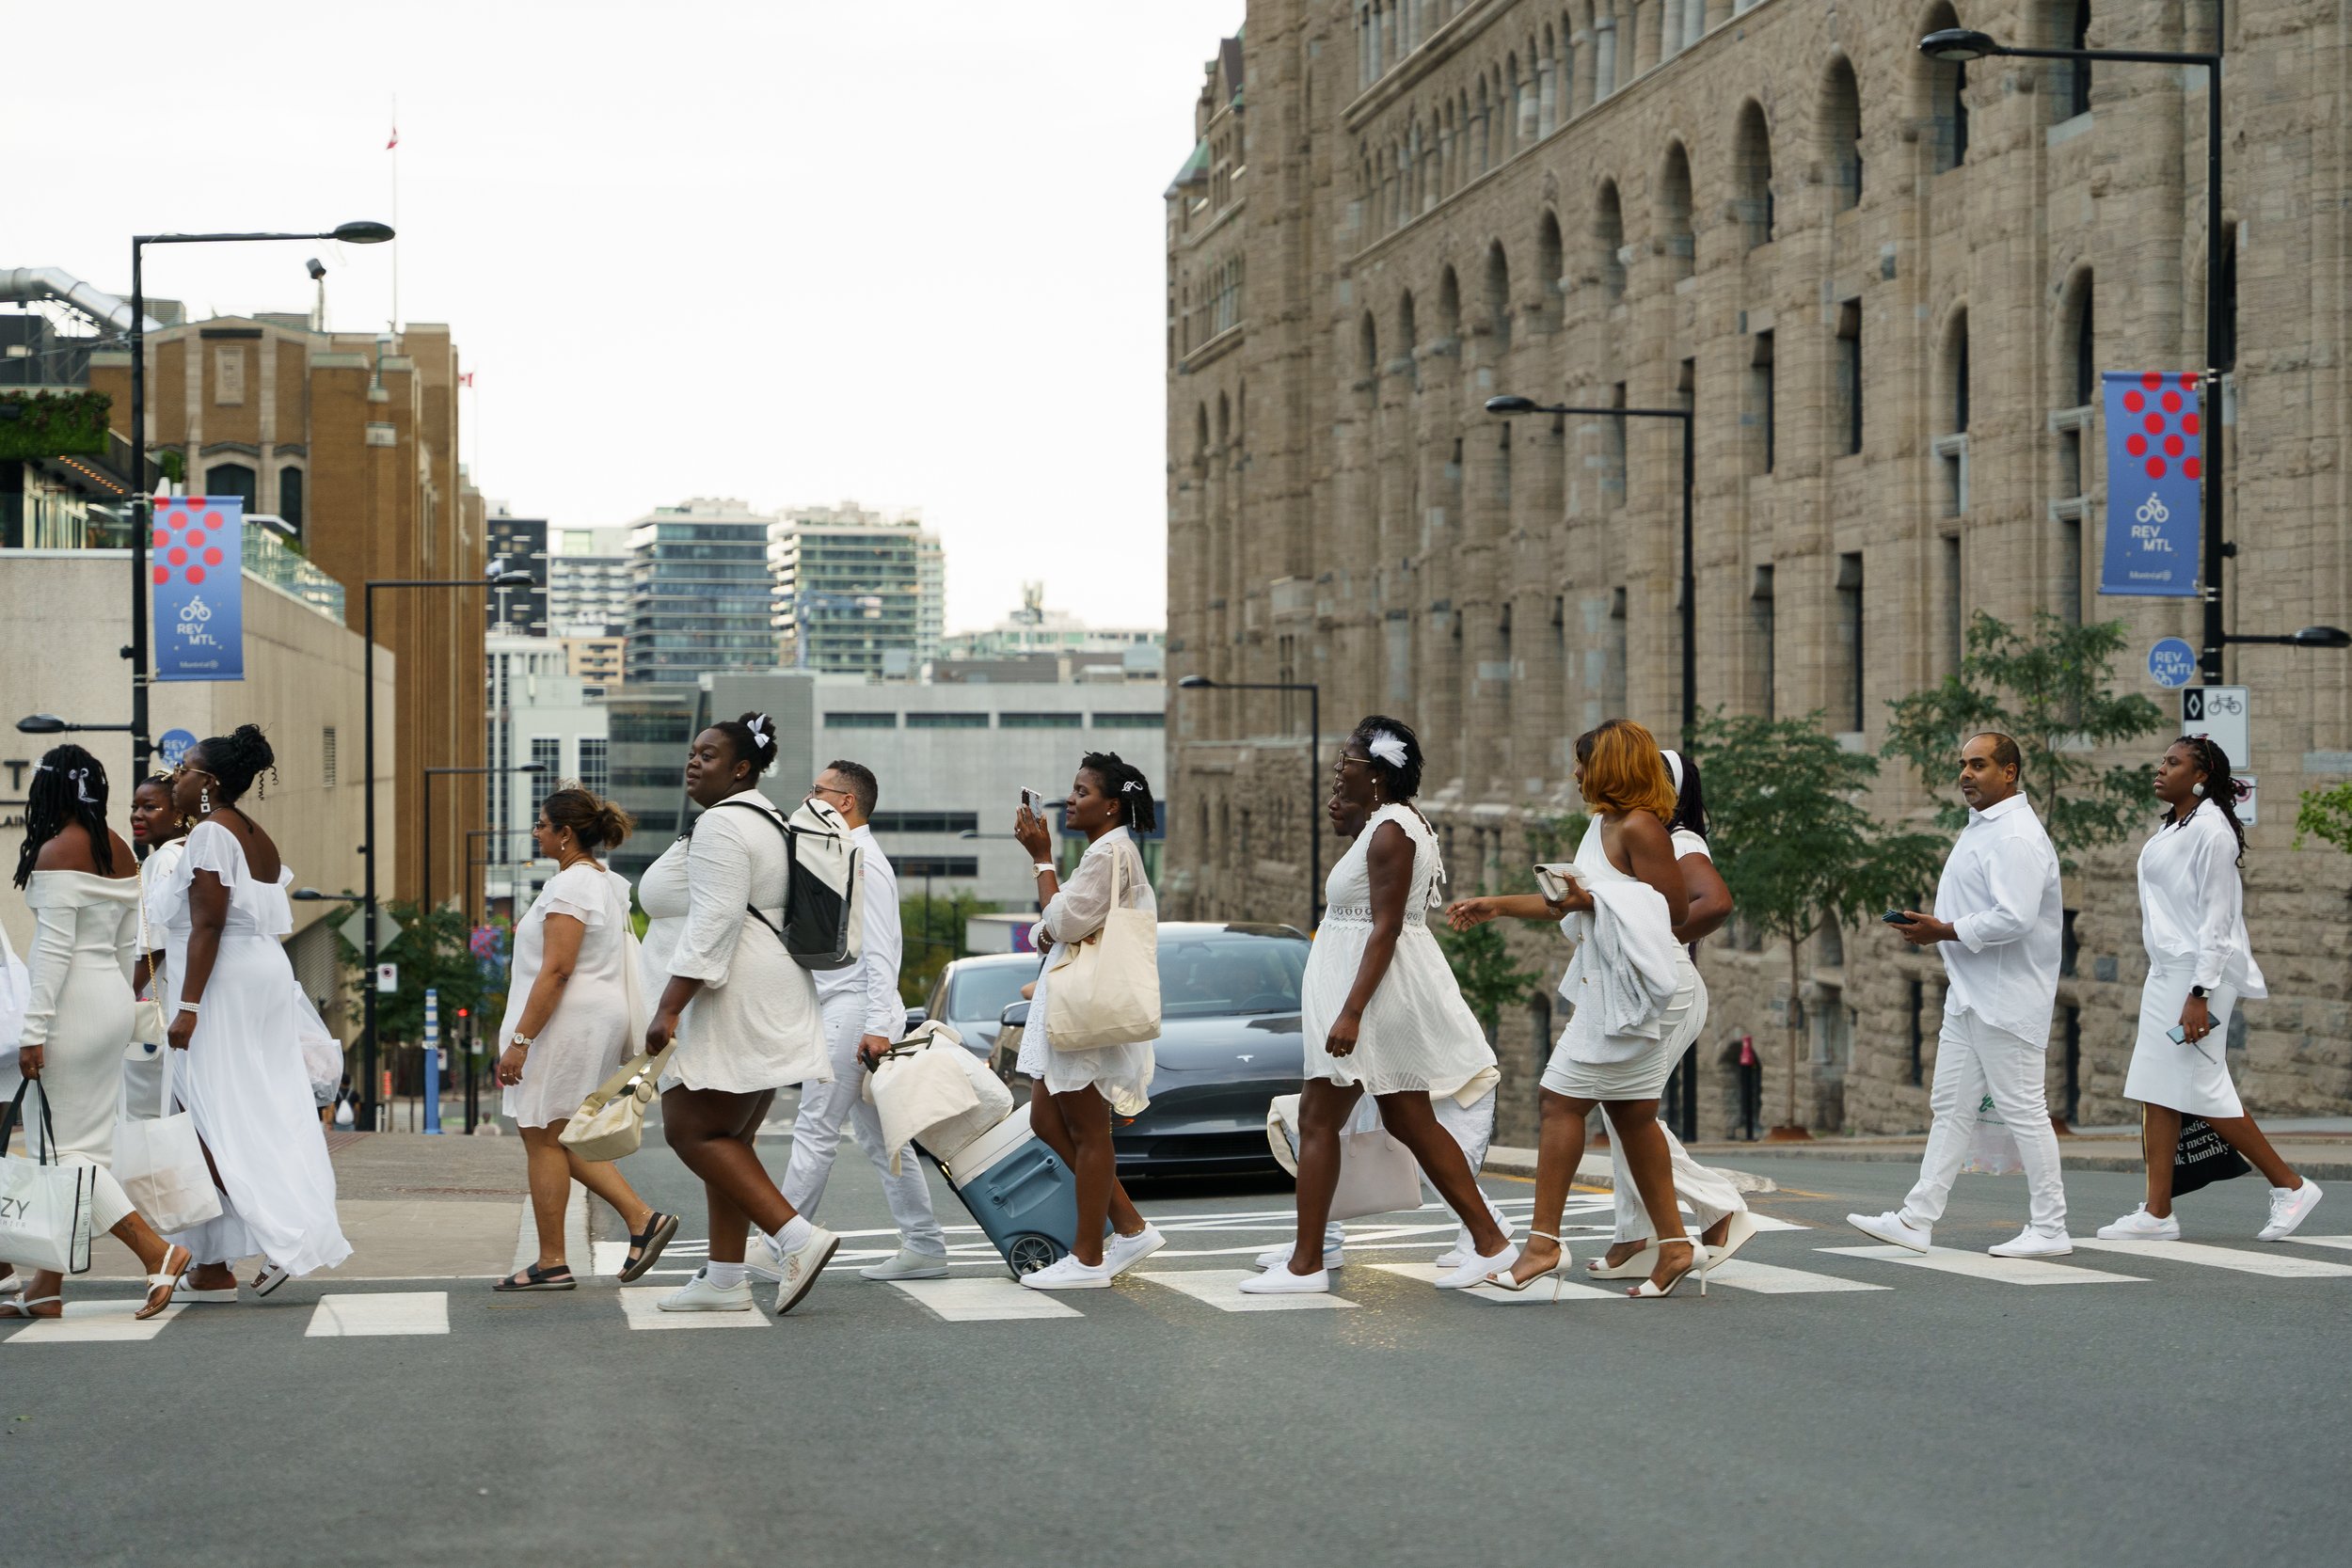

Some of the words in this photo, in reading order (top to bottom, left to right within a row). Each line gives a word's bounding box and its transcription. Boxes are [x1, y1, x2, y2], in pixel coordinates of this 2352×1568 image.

[2131, 525, 2161, 538] REV
[2143, 538, 2172, 551] MTL
[176, 623, 204, 634] REV
[189, 634, 217, 645] MTL
[2154, 651, 2183, 663] REV
[2186, 1141, 2230, 1164] humbly
[0, 1196, 31, 1220] ZY
[0, 1218, 26, 1229] HIER
